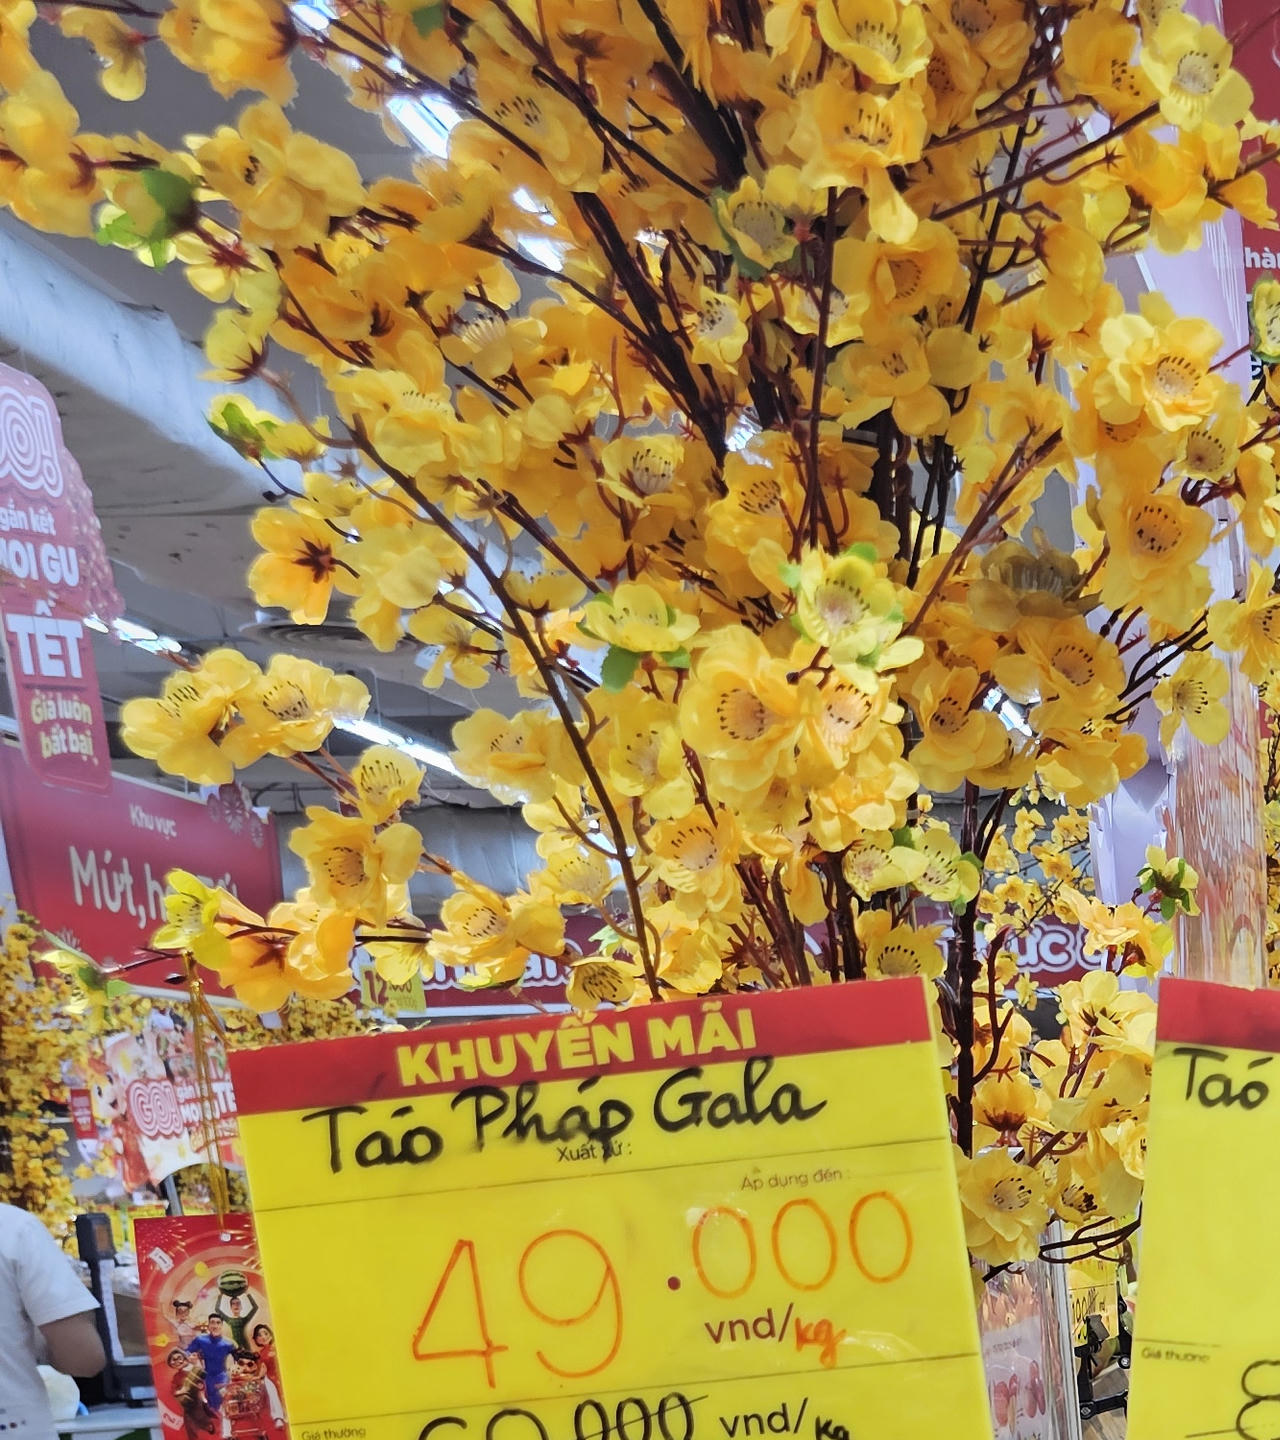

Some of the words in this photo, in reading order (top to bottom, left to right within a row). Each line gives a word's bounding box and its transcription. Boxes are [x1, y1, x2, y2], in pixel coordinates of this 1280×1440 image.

[29, 504, 57, 538] kết
[40, 544, 81, 588] GU
[7, 592, 83, 679] TẾT
[129, 803, 155, 831] Khu
[397, 1013, 635, 1088] KHUYẾN
[648, 1000, 756, 1066] MÃI
[450, 1075, 636, 1164] Pháp
[651, 1055, 829, 1134] Gala
[556, 1141, 600, 1164] Xuất
[768, 1169, 810, 1193] dụng
[811, 1166, 843, 1184] đến
[411, 1188, 914, 1390] 49.000
